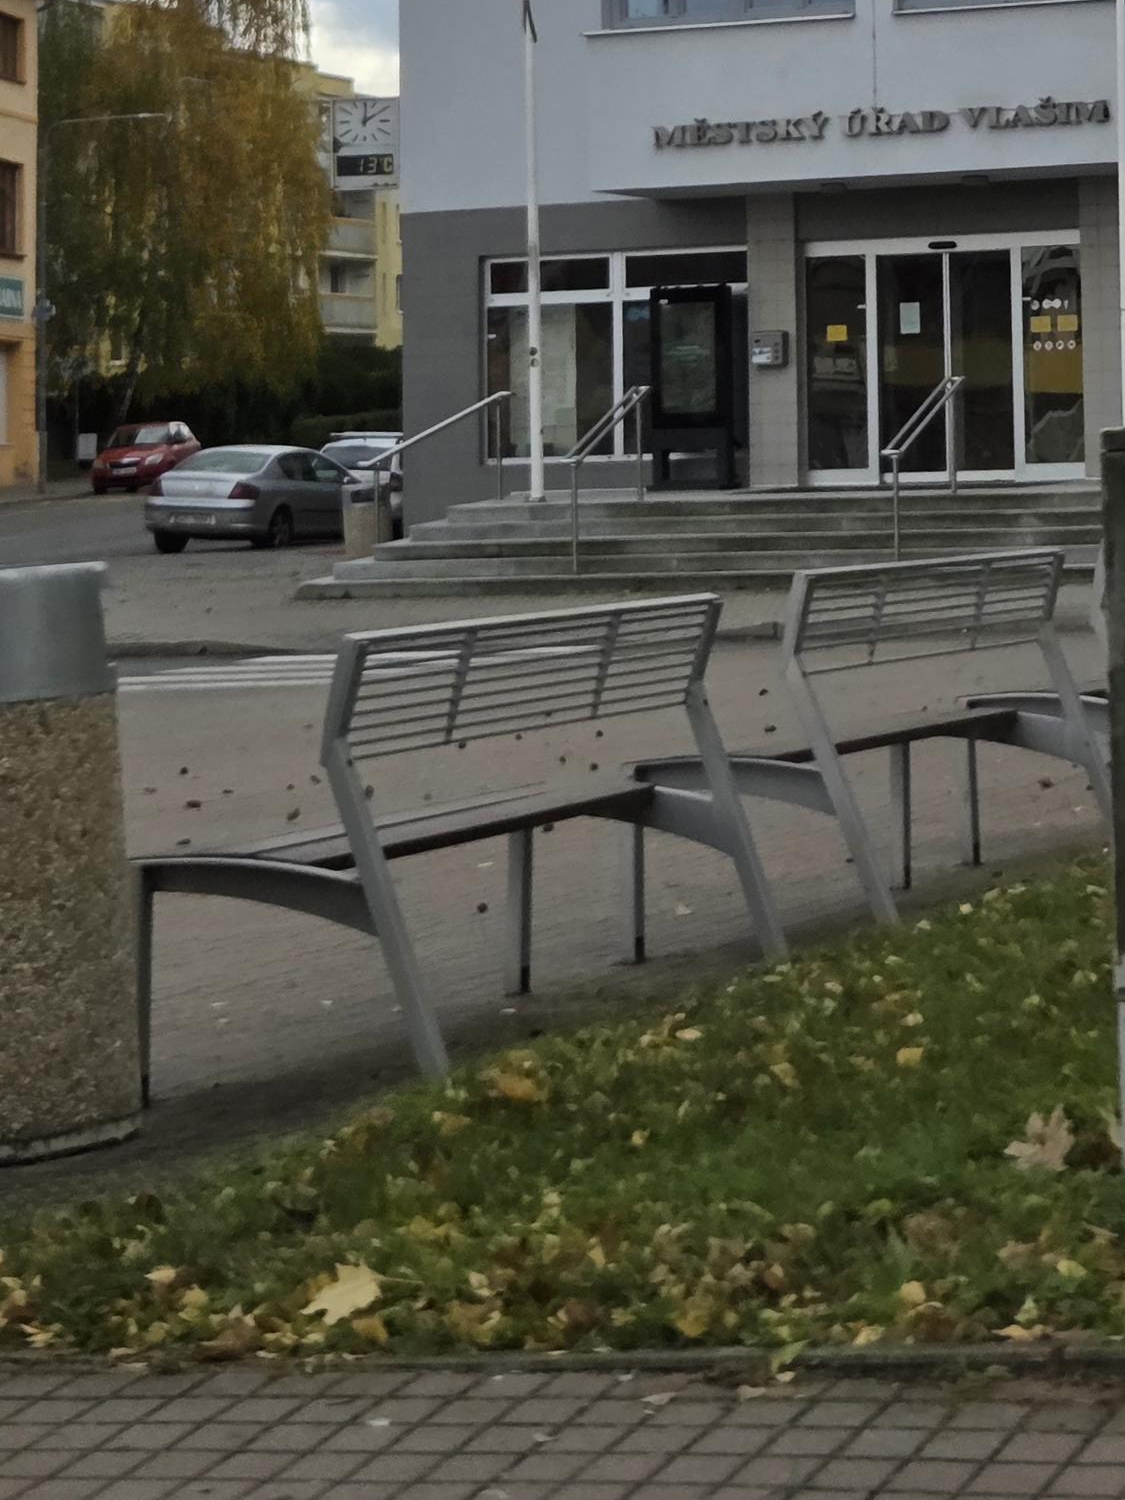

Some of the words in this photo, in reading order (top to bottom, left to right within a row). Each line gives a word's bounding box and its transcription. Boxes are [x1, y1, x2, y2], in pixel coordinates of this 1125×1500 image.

[653, 110, 830, 151] MĚSTSKÝ
[842, 106, 951, 138] ÚŘAD
[960, 96, 1112, 132] VLAŠIM
